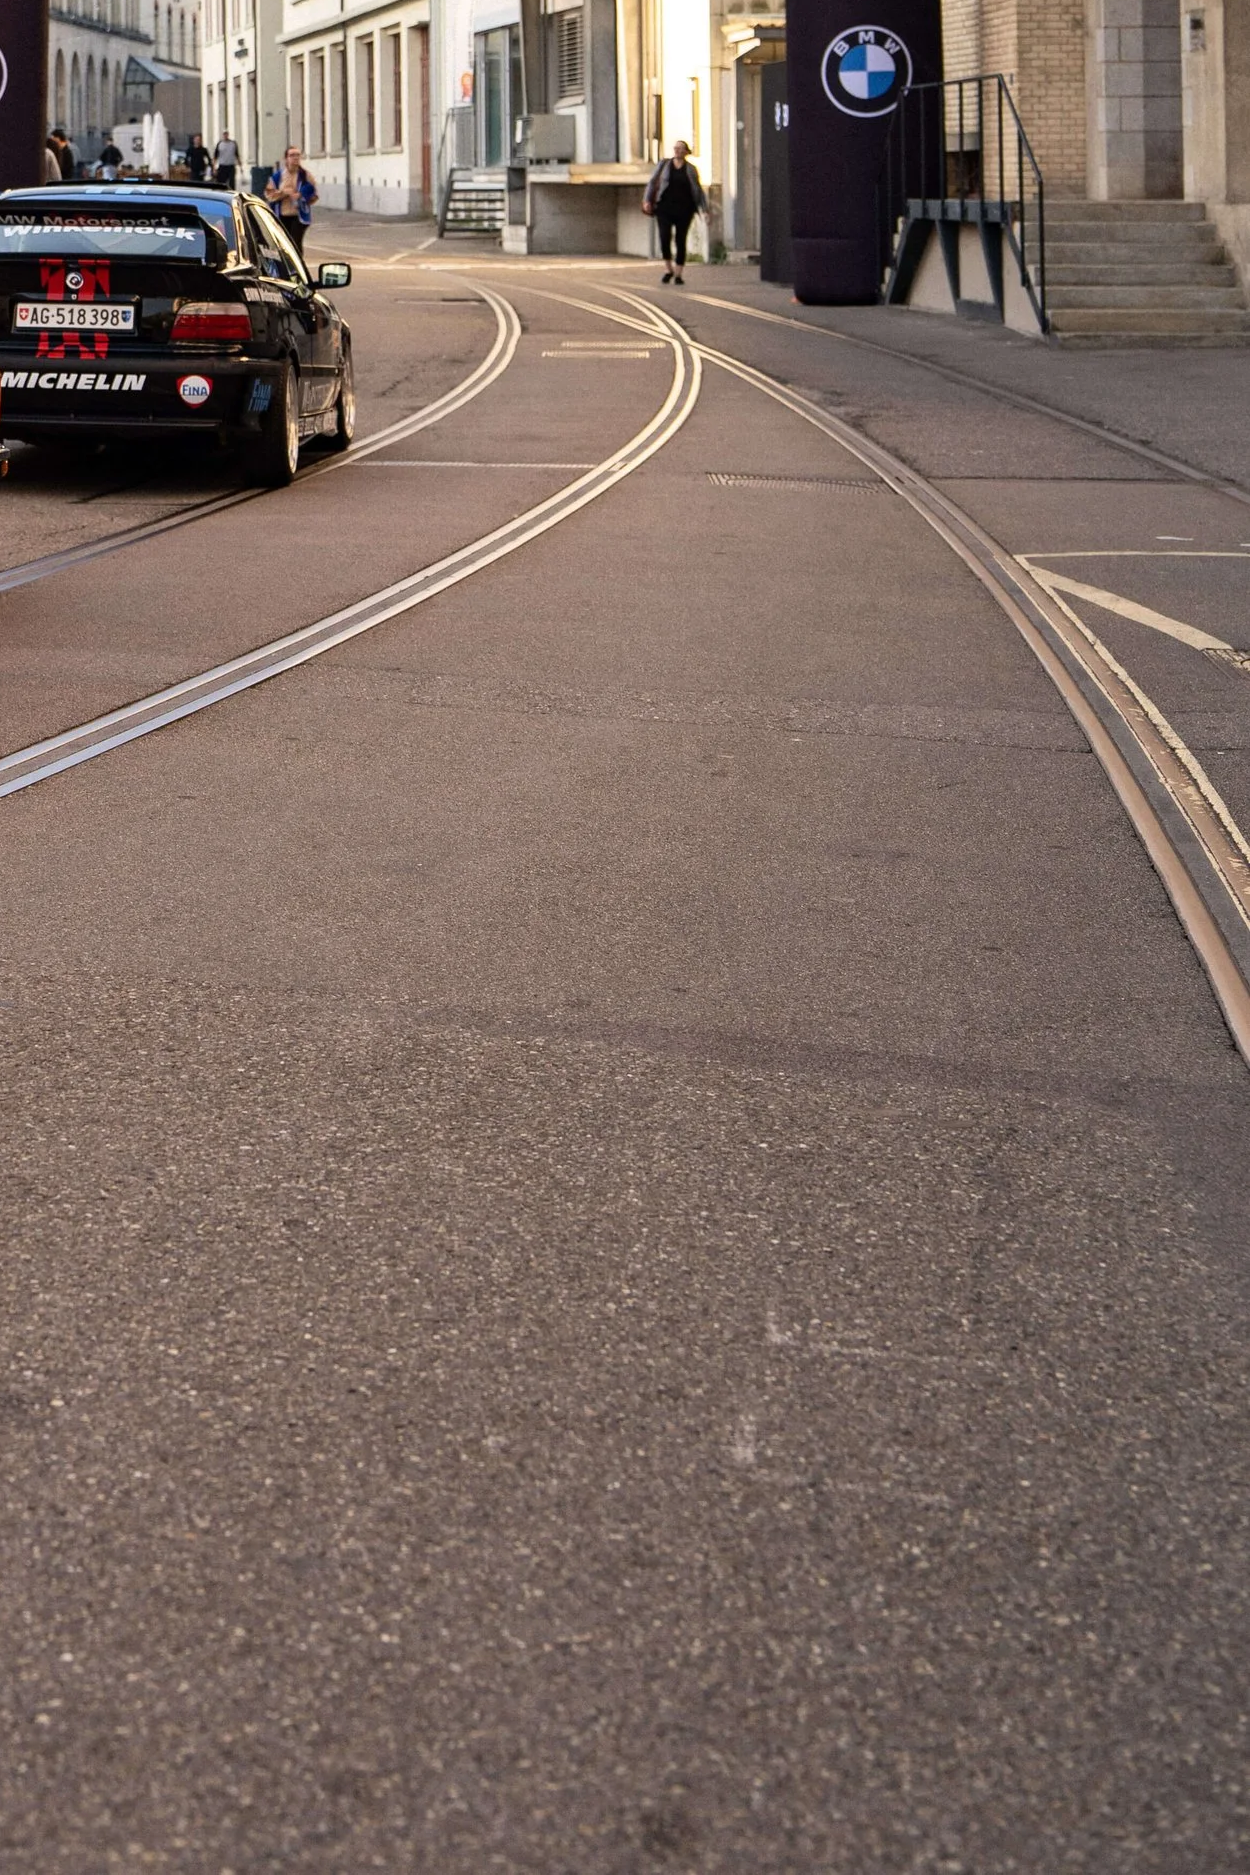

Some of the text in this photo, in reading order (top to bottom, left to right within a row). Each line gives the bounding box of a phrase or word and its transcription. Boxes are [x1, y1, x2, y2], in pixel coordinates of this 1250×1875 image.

[833, 30, 901, 57] BMW
[42, 215, 170, 226] Motorsport
[0, 372, 147, 391] MICHELIN
[182, 384, 210, 397] FINA
